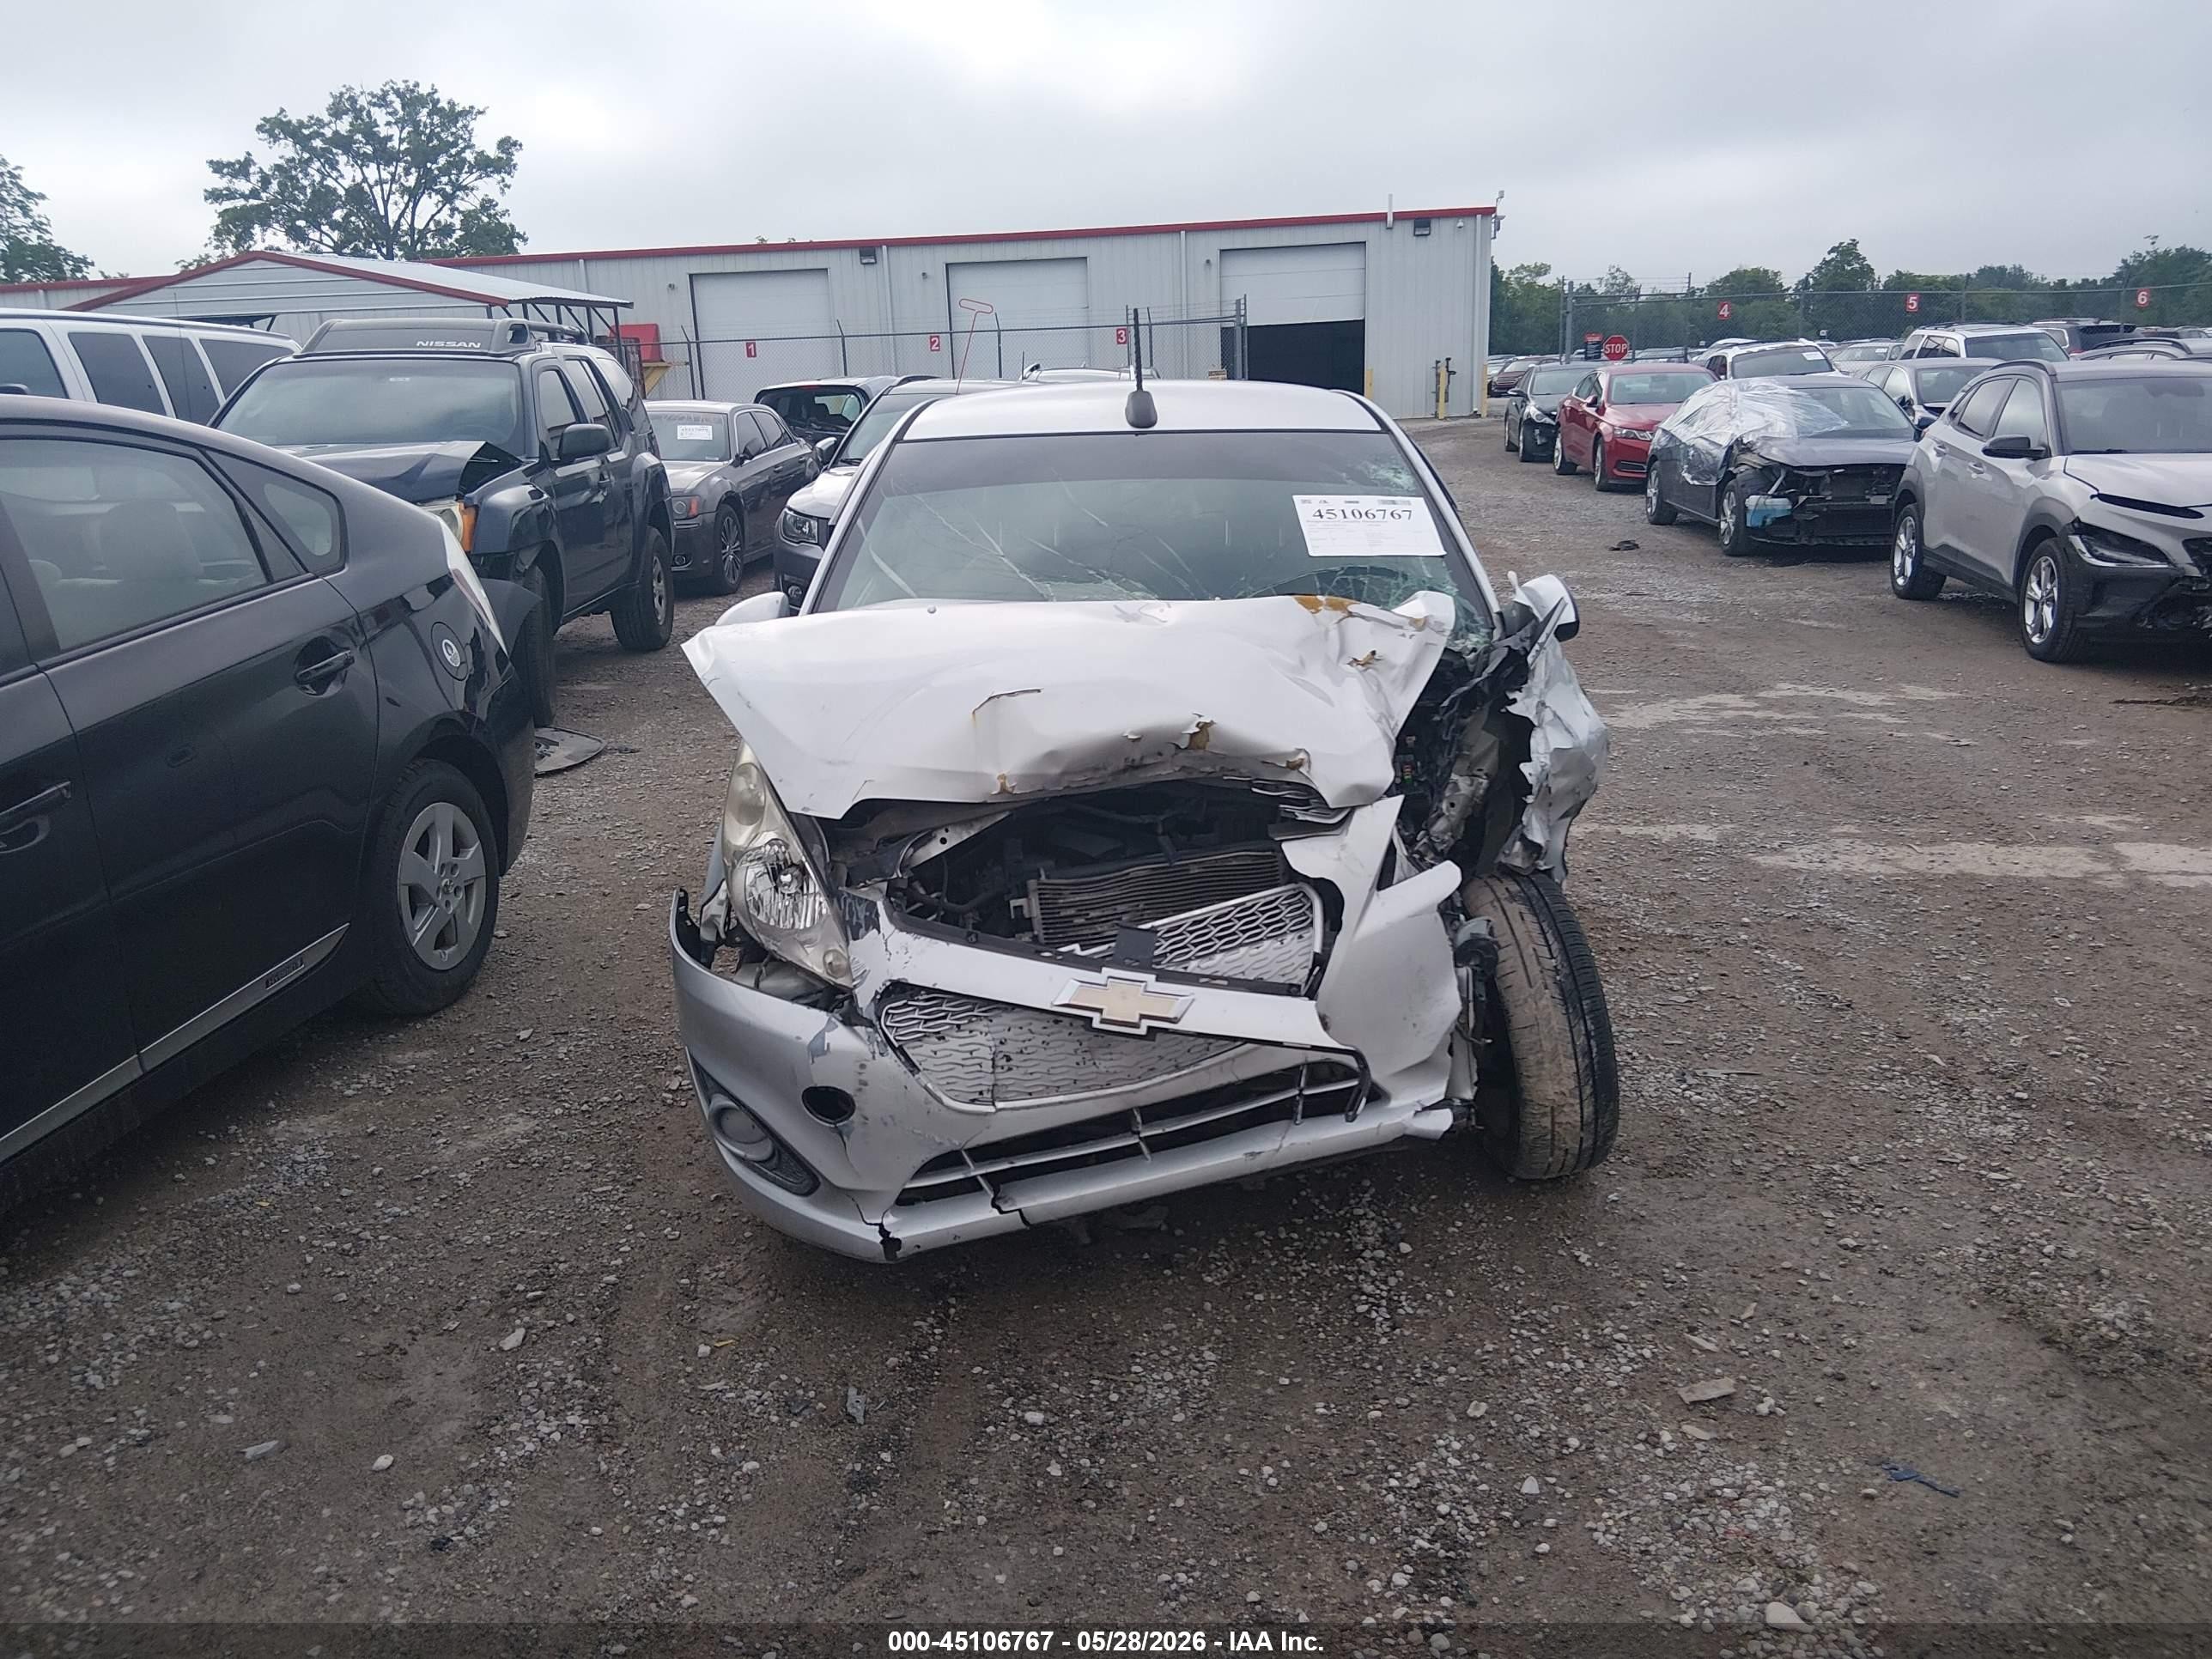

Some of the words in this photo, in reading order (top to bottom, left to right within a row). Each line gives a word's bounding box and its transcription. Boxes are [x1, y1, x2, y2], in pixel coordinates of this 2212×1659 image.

[1908, 296, 1917, 310] 5
[2137, 291, 2148, 305] 6
[1719, 304, 1730, 318] 4
[1117, 330, 1127, 343] 3
[416, 340, 481, 349] NISSAN
[748, 343, 755, 356] 1
[931, 337, 939, 350] 2
[1605, 343, 1627, 354] STOP
[1312, 508, 1413, 520] 45106767
